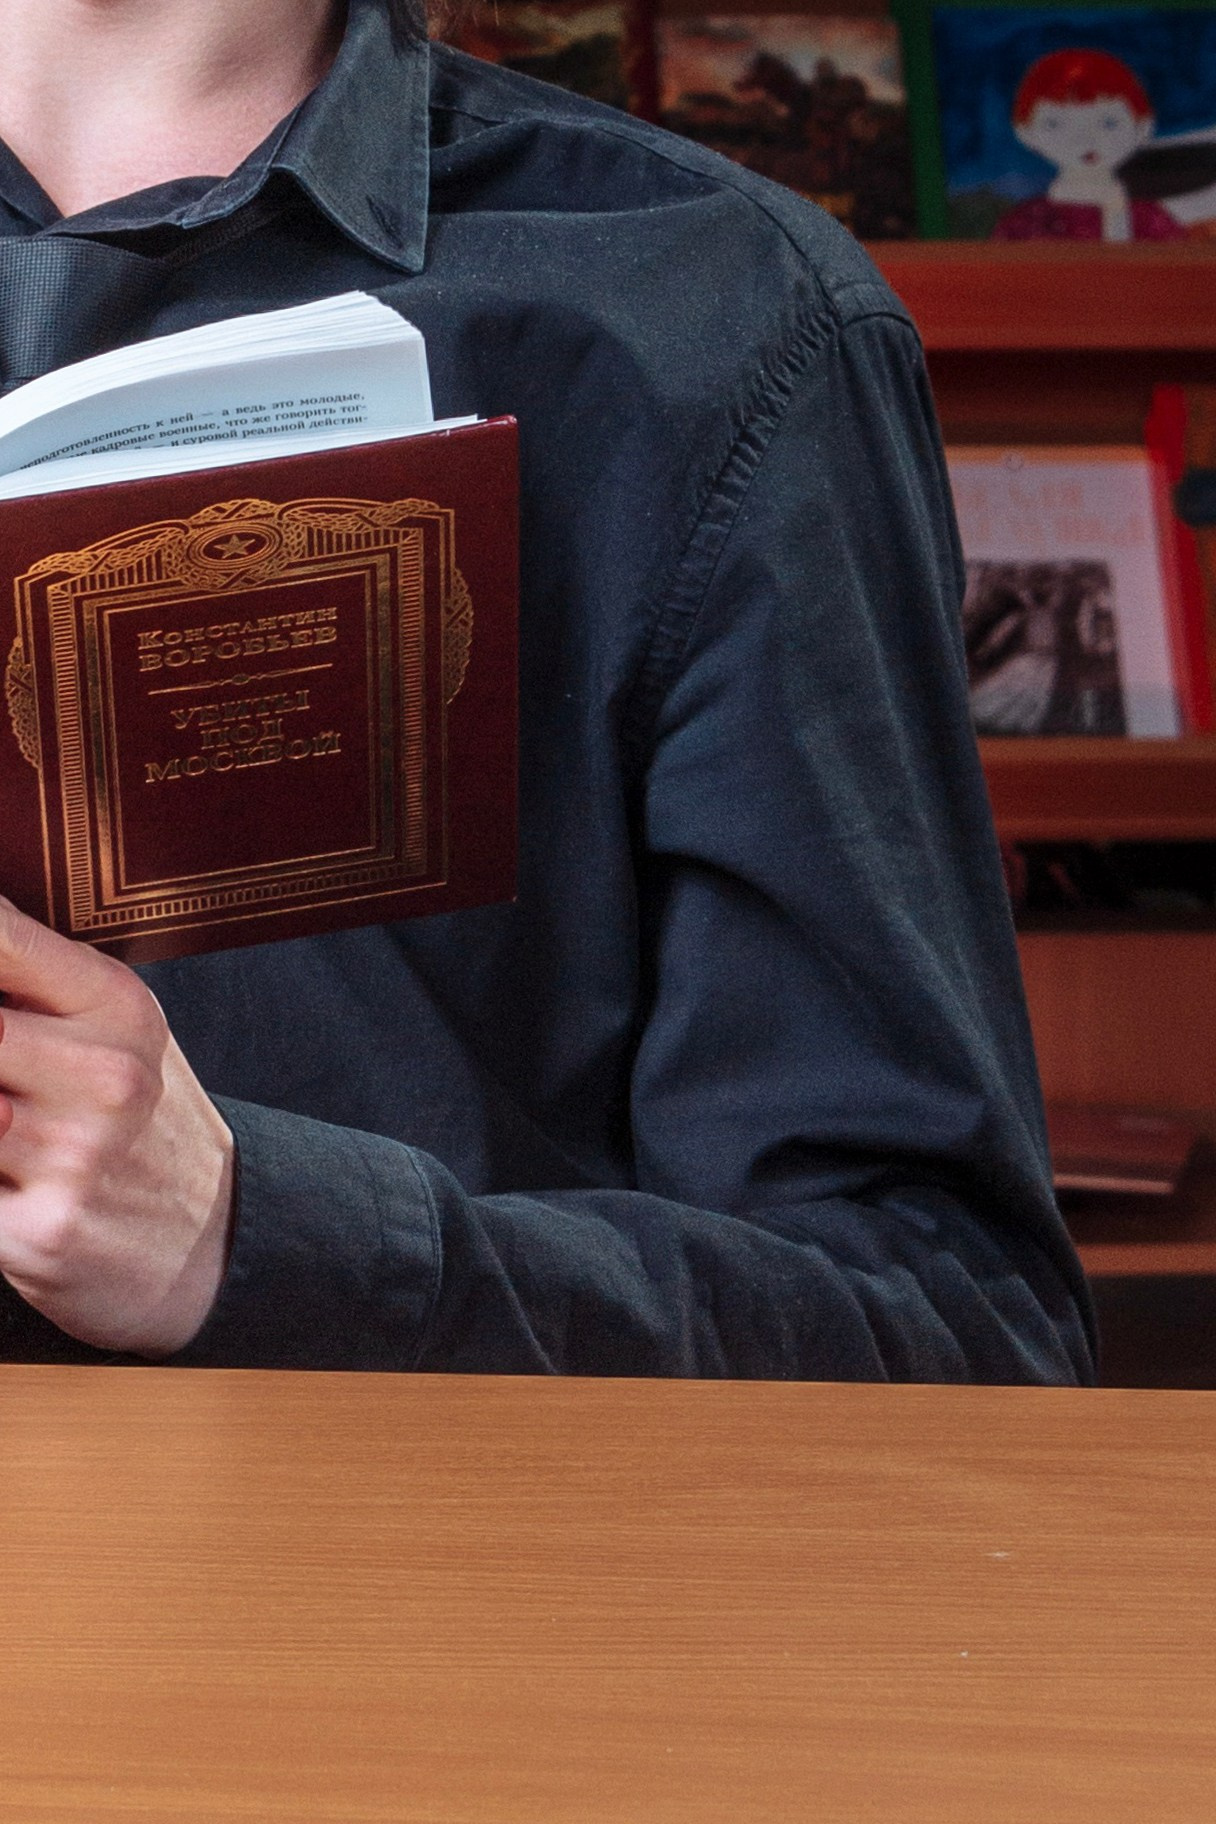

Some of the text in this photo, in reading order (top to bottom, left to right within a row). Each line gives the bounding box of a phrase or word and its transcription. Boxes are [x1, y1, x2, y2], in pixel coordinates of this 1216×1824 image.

[91, 433, 155, 454] кадровые
[159, 423, 220, 438] военные,
[225, 418, 248, 427] что
[251, 416, 271, 424] же
[275, 408, 336, 421] говорить
[340, 404, 367, 414] тог-
[156, 419, 164, 428] к
[170, 412, 194, 425] ней
[236, 404, 266, 415] ведь
[272, 400, 294, 410] это
[300, 393, 364, 406] молодые,
[183, 429, 238, 445] суровой
[242, 421, 305, 439] реальной
[309, 416, 368, 429] действи-
[138, 626, 338, 672] ВОРОБЬЕВ
[170, 689, 311, 730] УБИТЫ
[200, 718, 284, 750] ПОД
[145, 731, 342, 783] МОСКВОЙ
